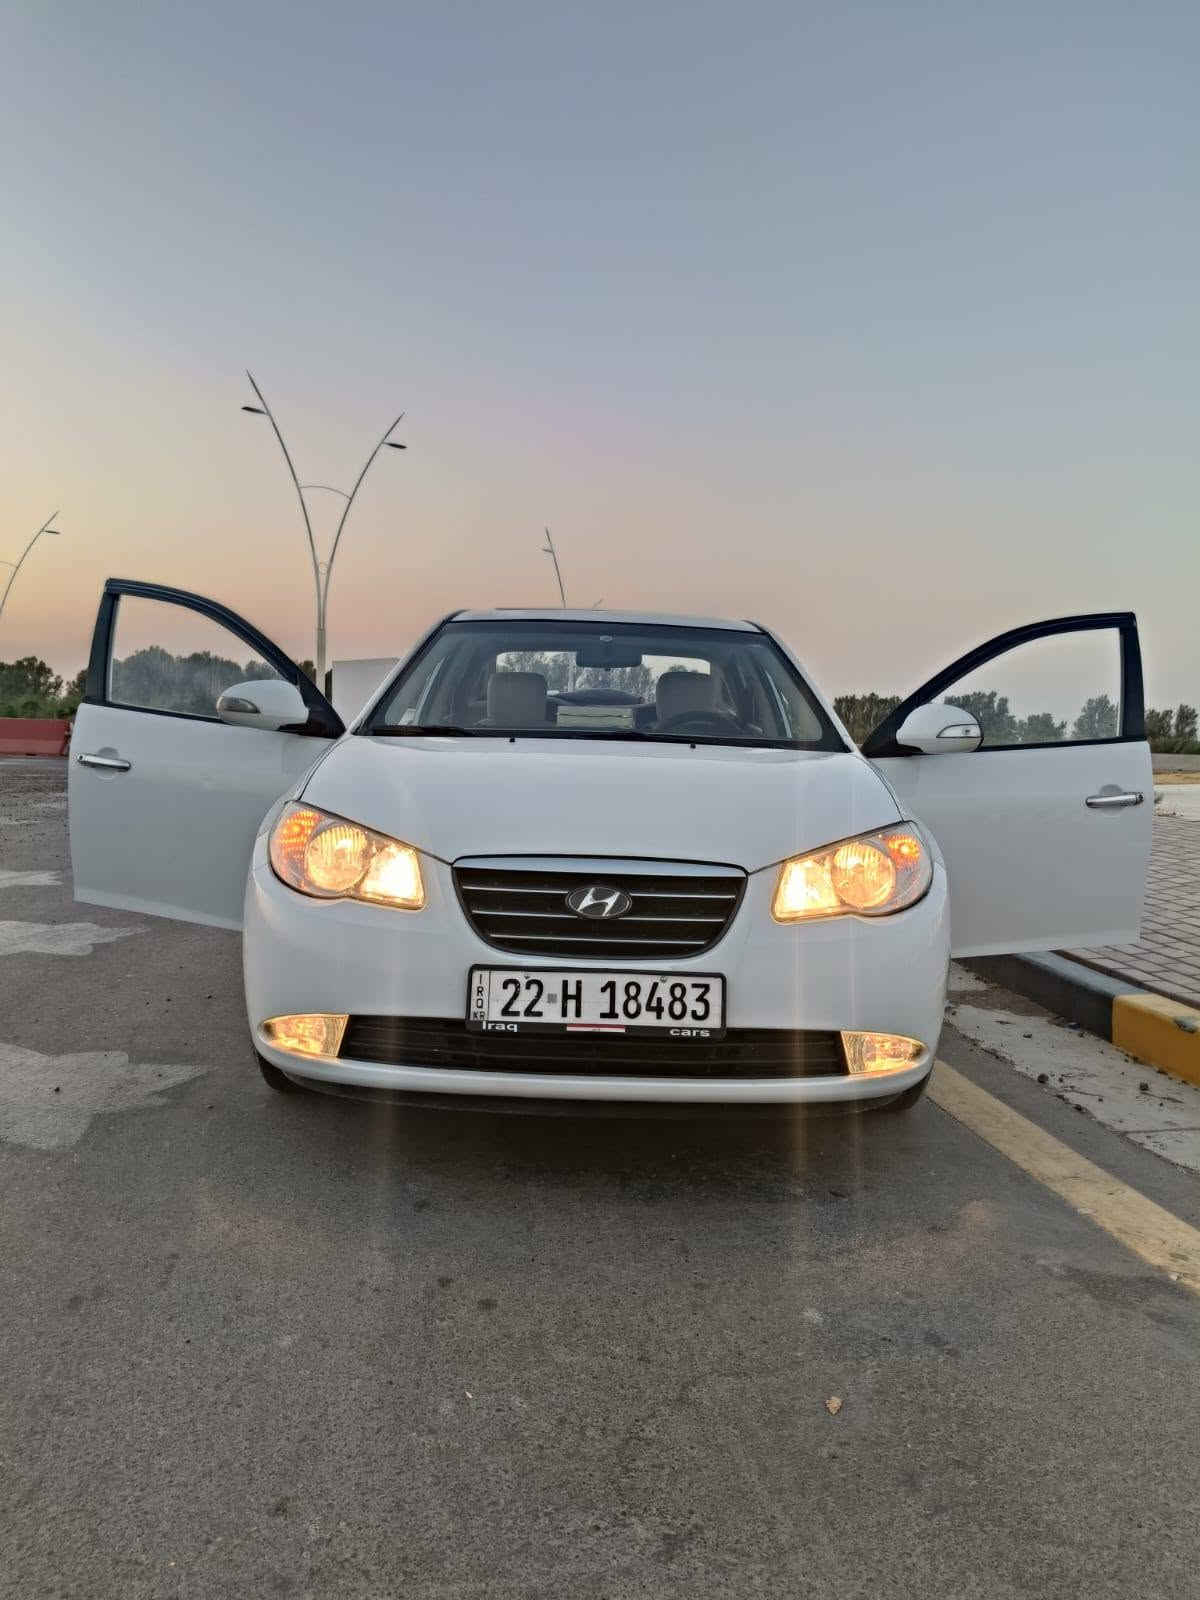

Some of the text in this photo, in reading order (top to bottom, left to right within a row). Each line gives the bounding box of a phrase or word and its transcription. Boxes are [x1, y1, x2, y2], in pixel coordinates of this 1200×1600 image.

[501, 978, 711, 1021] 22 H 18483
[482, 1020, 518, 1032] Iraq
[669, 1028, 710, 1037] cars
